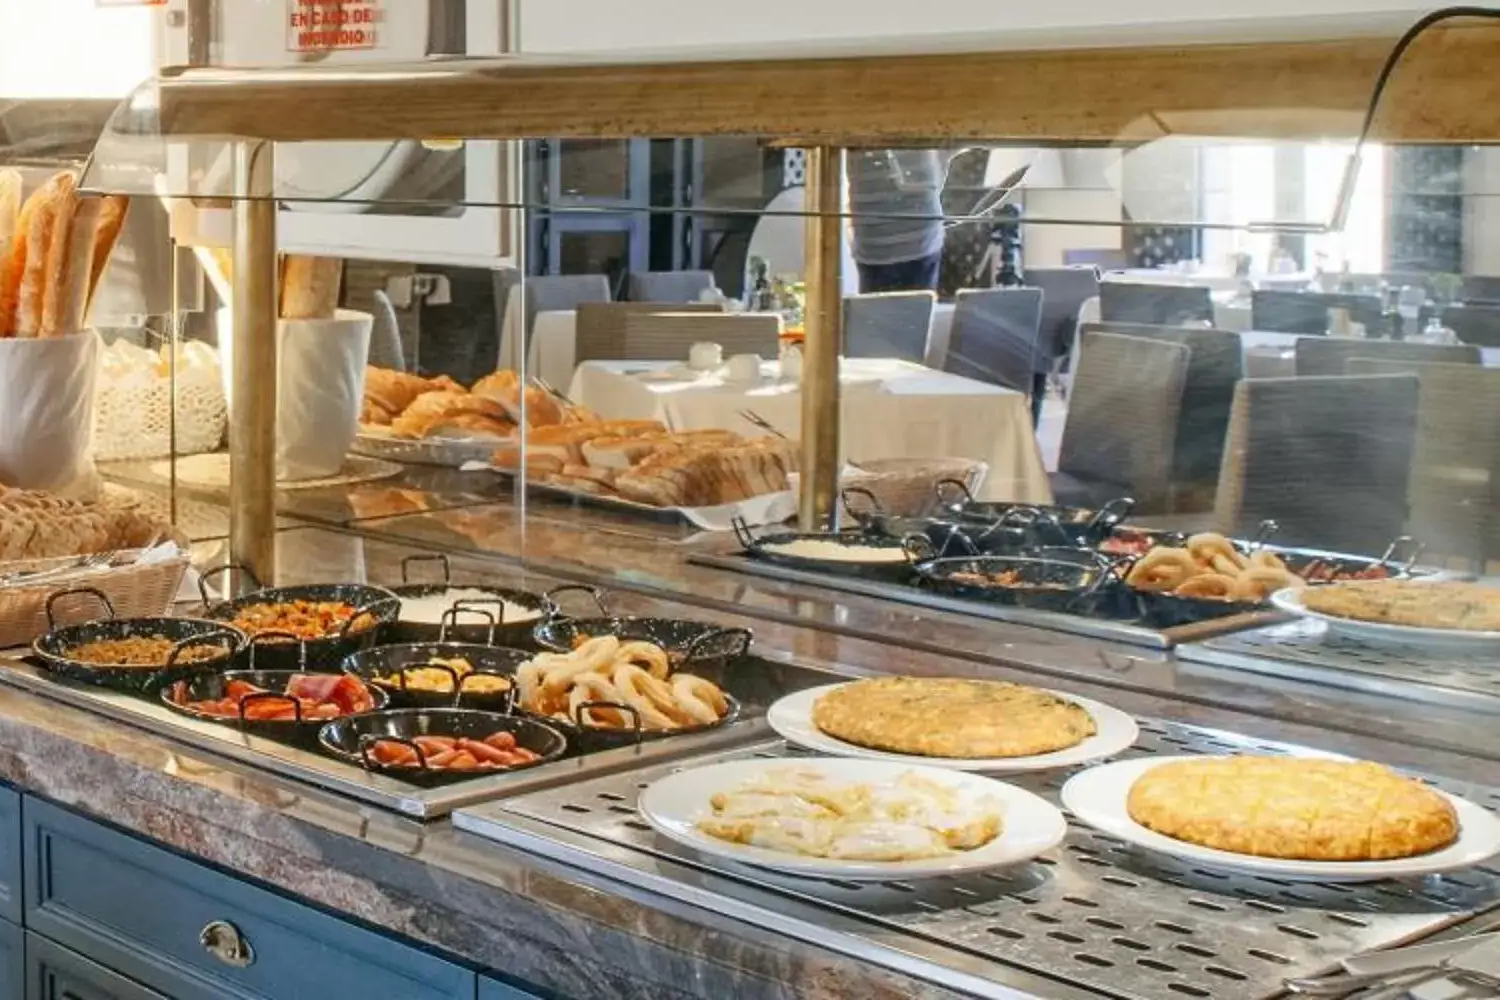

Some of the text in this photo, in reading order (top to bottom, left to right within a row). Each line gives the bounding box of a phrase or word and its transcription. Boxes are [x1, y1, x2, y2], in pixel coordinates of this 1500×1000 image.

[291, 9, 372, 28] EN CASO DE
[298, 30, 363, 46] INCENDIO
